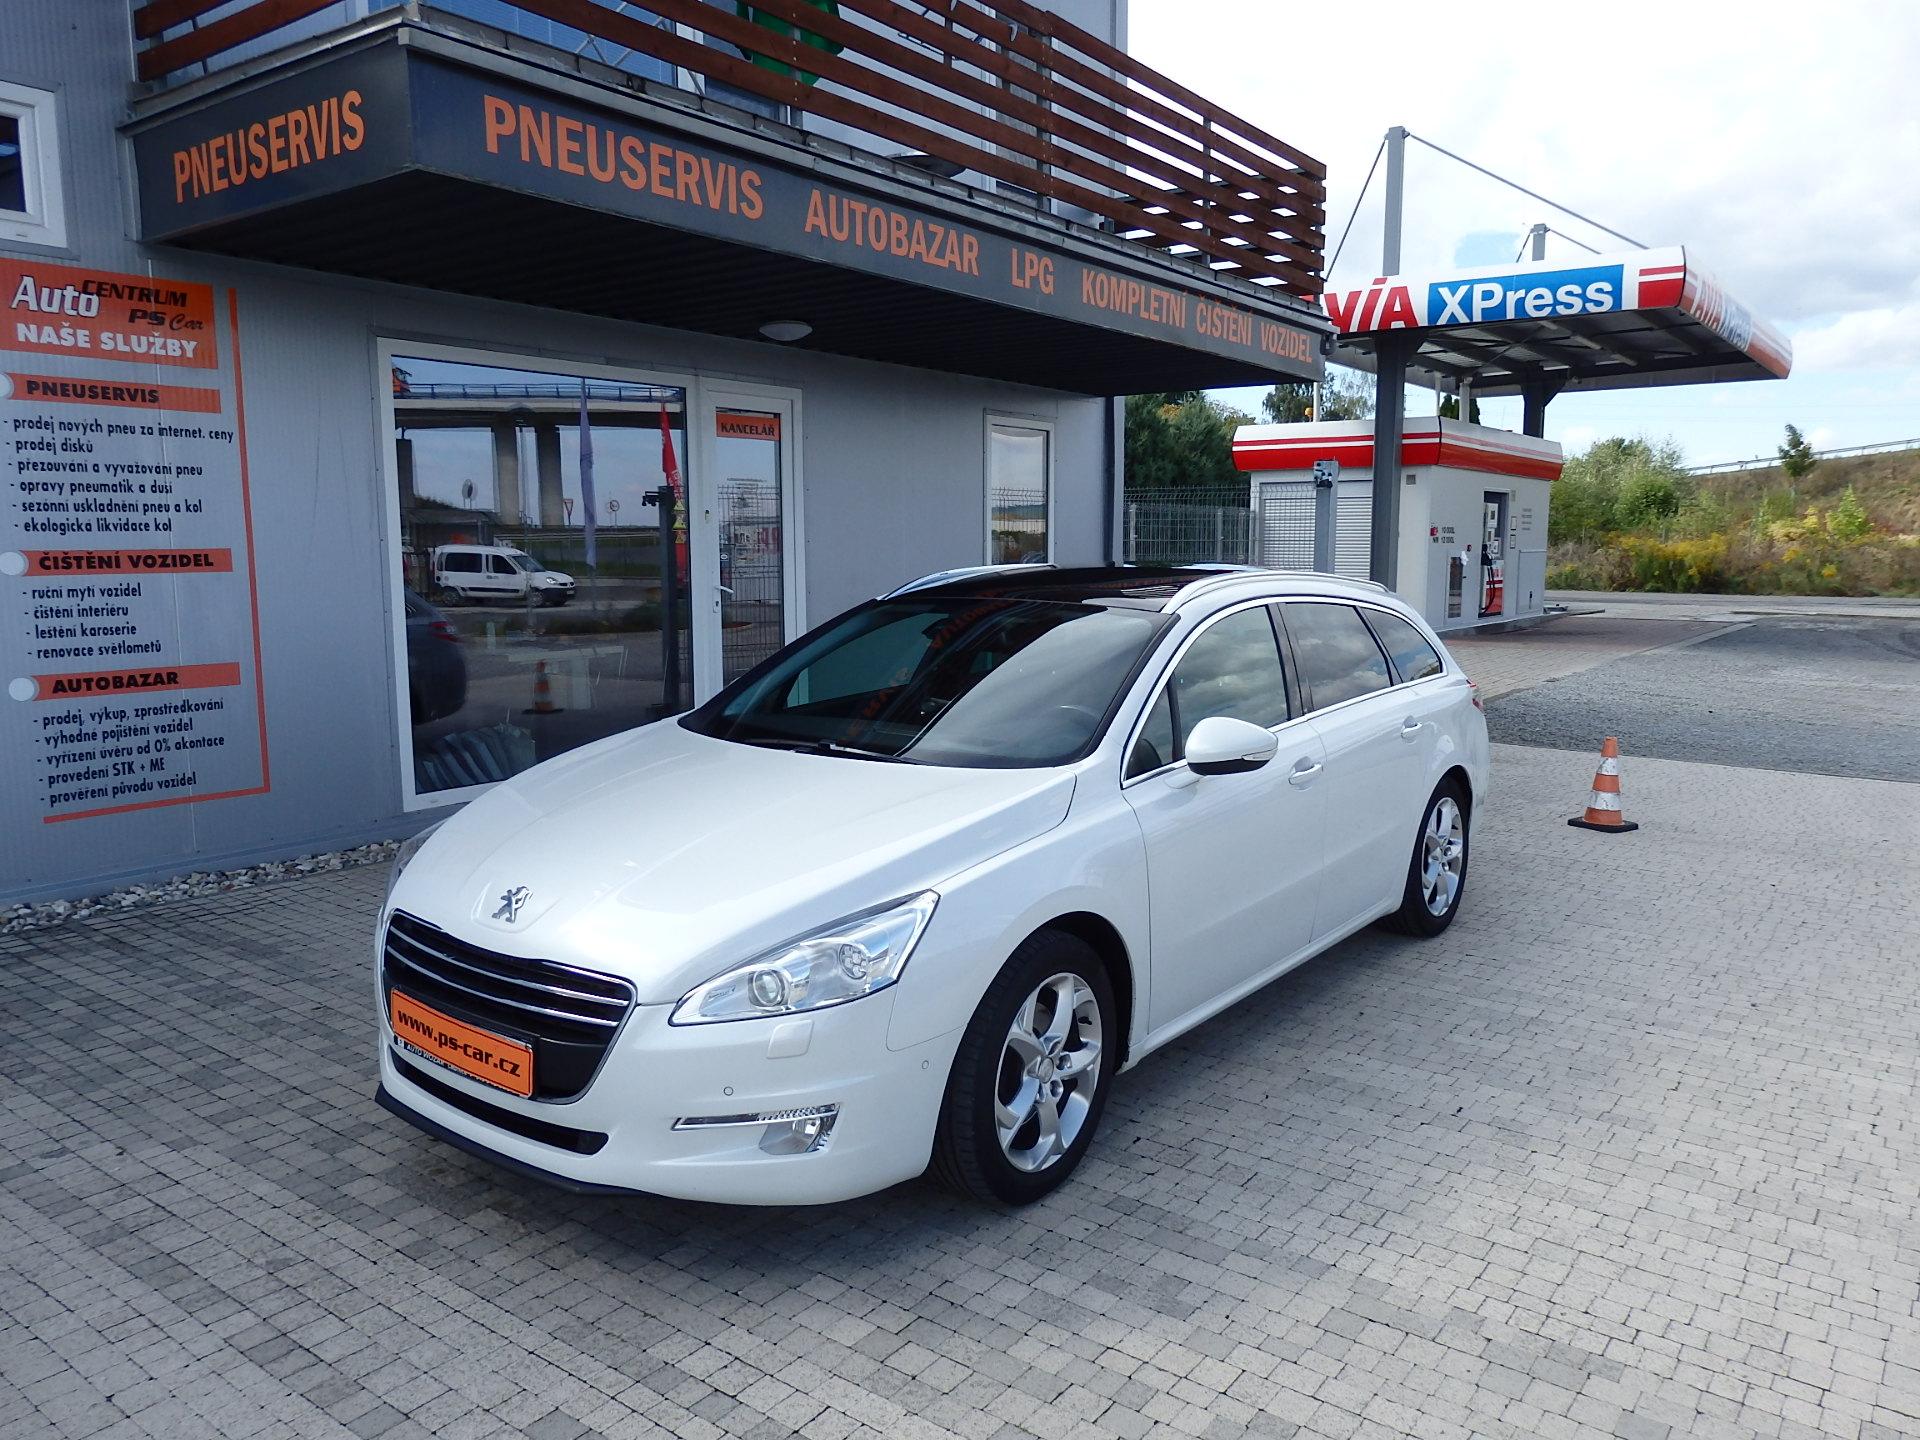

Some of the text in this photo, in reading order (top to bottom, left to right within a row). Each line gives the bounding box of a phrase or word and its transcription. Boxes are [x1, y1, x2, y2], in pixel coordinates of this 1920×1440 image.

[173, 89, 366, 203] PNEUSERVIS
[483, 94, 1313, 363] PNEUSERVIS AUTOBAZAR LPG KOMPLETNÍ ČIŠTĚNÍ VOZIDEL
[10, 275, 187, 318] Auto CENTRUM
[1437, 281, 1613, 324] XPress
[128, 308, 167, 326] PS
[17, 321, 198, 358] NAŠE SLUŽBY
[26, 380, 160, 403] PNEUSERVIS
[13, 415, 55, 434] prodej
[58, 419, 103, 437] nových
[107, 423, 136, 438] pneu
[140, 425, 154, 436] za
[209, 429, 234, 444] ceny
[721, 422, 775, 437] KANCELÁŘ
[15, 438, 57, 455] prodej
[92, 463, 100, 474] a
[104, 459, 173, 477] vyvažování
[176, 464, 203, 479] pneu
[19, 480, 65, 496] opravy
[69, 479, 134, 495] pneumatik
[138, 483, 146, 493] a
[142, 502, 170, 516] pneu
[174, 502, 181, 513] a
[185, 499, 203, 513] kol
[96, 517, 150, 532] likvidace
[154, 518, 172, 533] kol
[39, 550, 214, 570] ČIŠTĚNÍ VOZIDEL
[100, 582, 142, 599] vozidel
[80, 622, 137, 638] karoserie
[37, 644, 94, 660] renovace
[52, 671, 180, 694] AUTOBAZAR
[43, 698, 224, 730] prodej, výkup, zprostředkování
[154, 717, 194, 736] vozidel
[137, 740, 151, 756] od
[154, 737, 171, 753] 0%
[175, 734, 225, 751] akontace
[113, 760, 136, 777] STK
[150, 756, 166, 773] ME
[157, 770, 197, 789] vozidel
[397, 1010, 521, 1077] www.ps-car.cz
